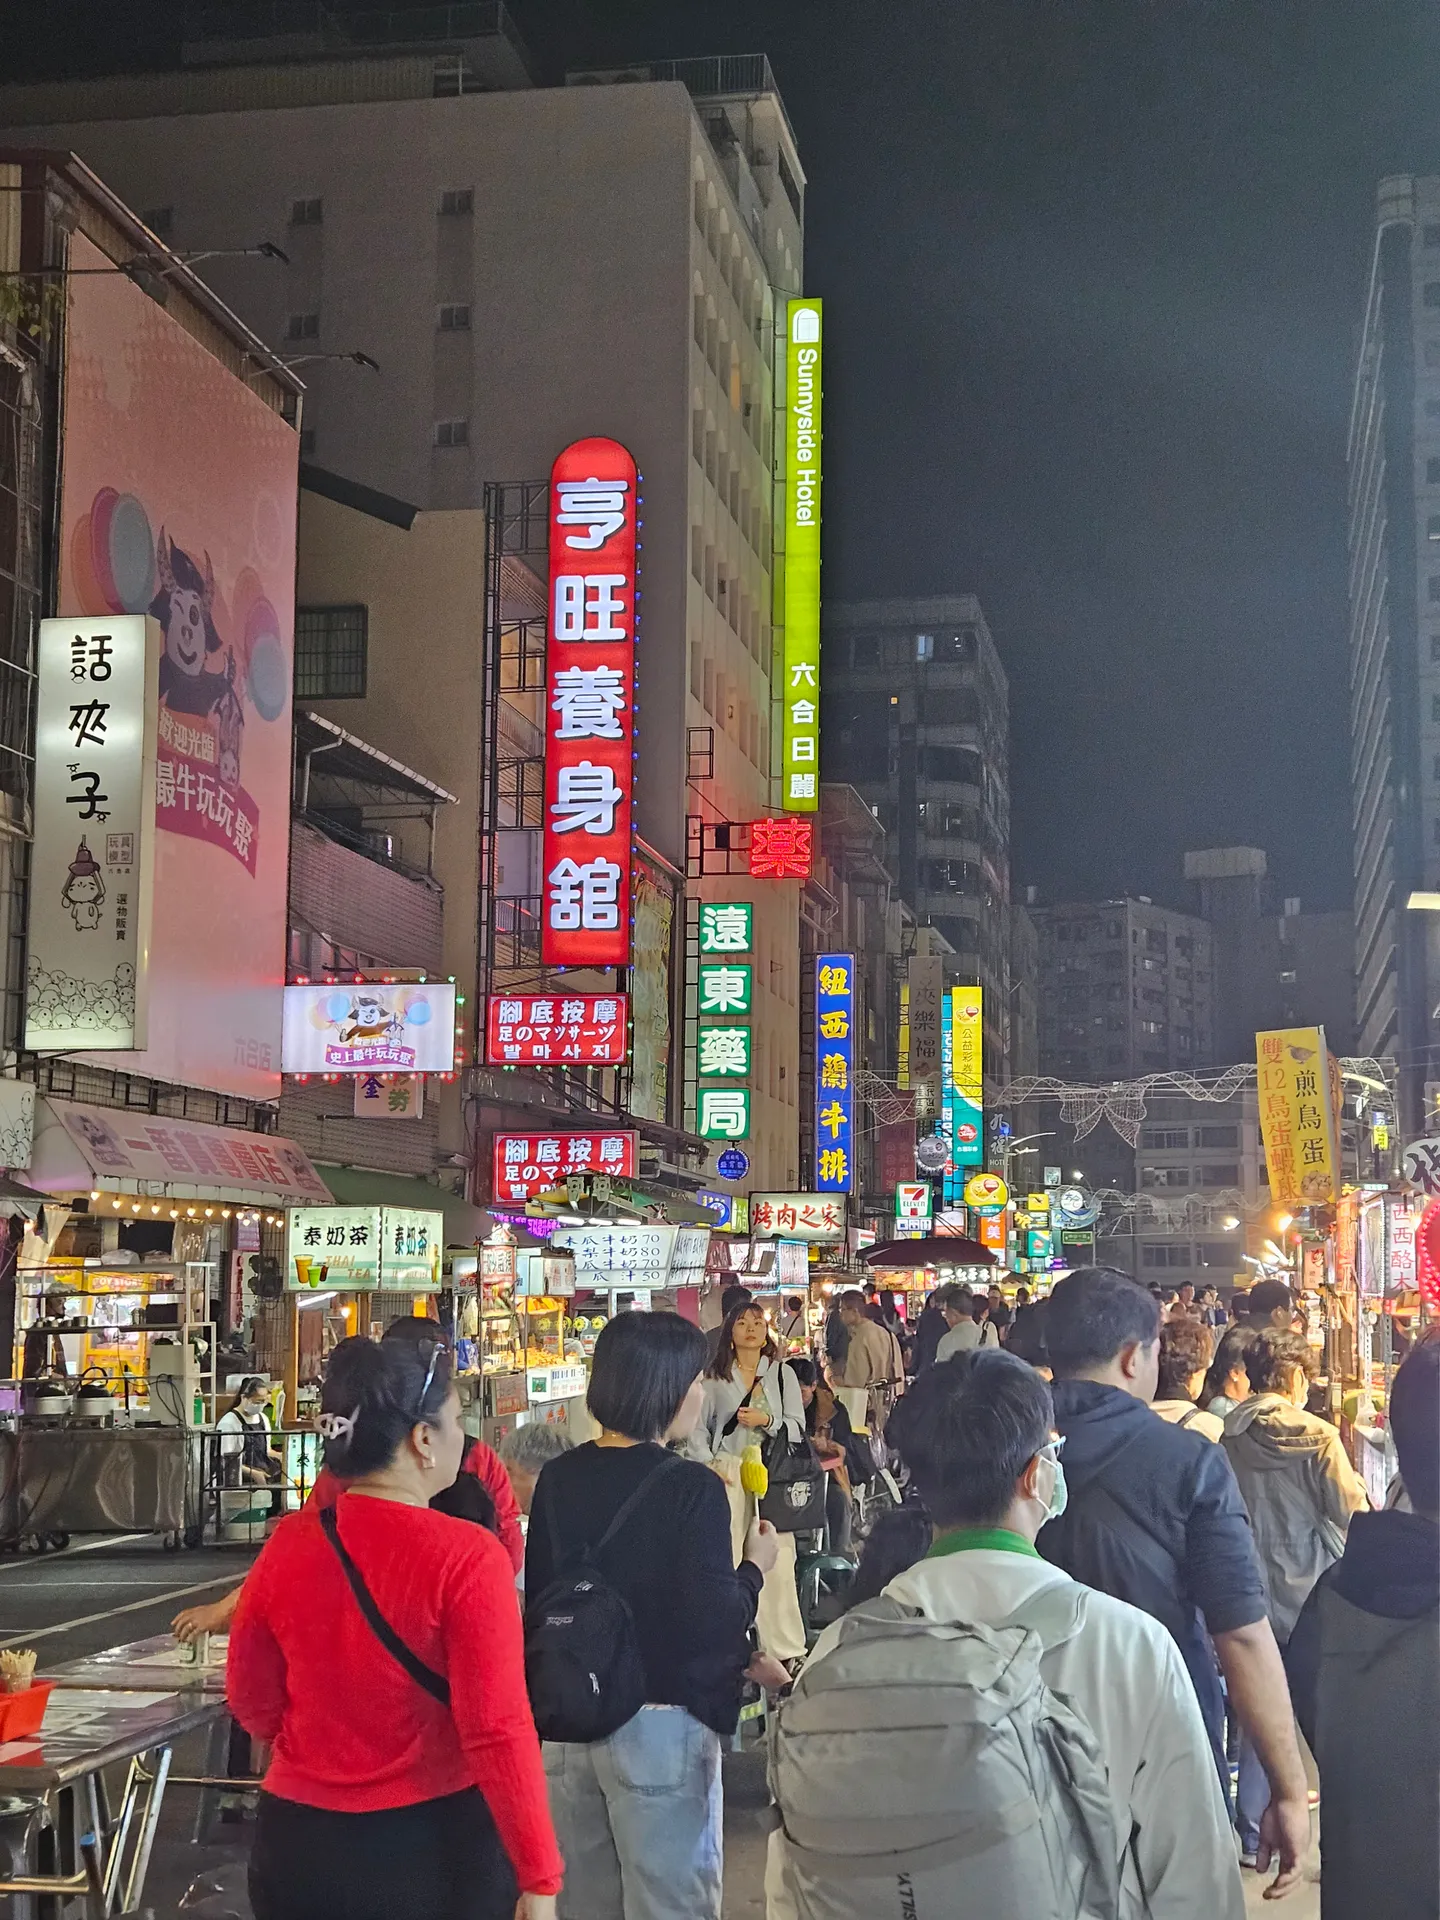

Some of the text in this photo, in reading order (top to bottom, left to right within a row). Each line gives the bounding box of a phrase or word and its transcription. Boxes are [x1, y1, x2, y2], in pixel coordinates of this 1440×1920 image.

[793, 348, 818, 527] Sunnyside Hotel
[790, 662, 817, 799] 六合日麗
[700, 905, 750, 1136] 遠東藥局
[503, 1043, 611, 1060] 발마사지
[818, 964, 851, 1186] 紐西蘭牛排
[1293, 1069, 1326, 1166] 煎鳥蛋
[752, 1201, 843, 1231] 烤肉之家
[303, 1225, 369, 1247] 泰奶茶
[642, 1233, 661, 1245] 70
[325, 1255, 356, 1268] THAI
[574, 1246, 661, 1259] 梨牛奶 80
[347, 1268, 371, 1280] TEA
[573, 1258, 661, 1271] 瓜牛奶 70
[642, 1270, 661, 1282] 50
